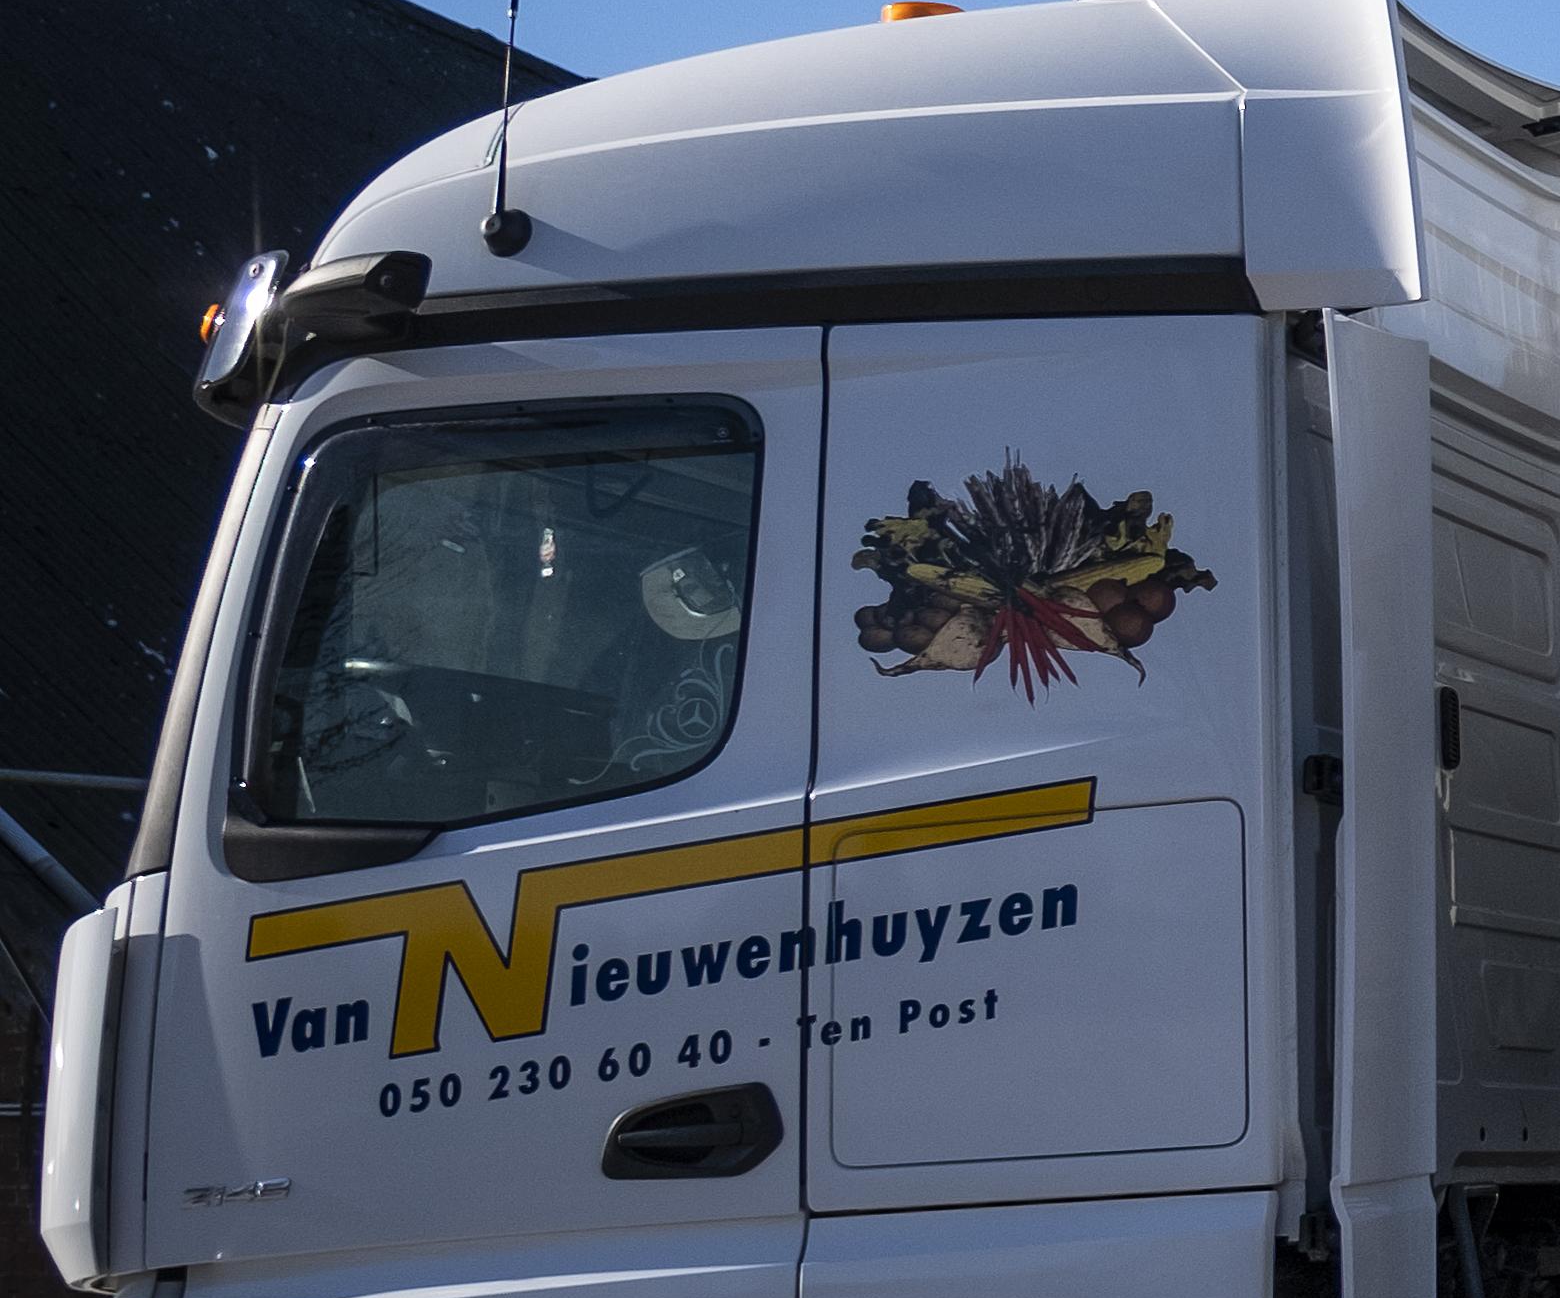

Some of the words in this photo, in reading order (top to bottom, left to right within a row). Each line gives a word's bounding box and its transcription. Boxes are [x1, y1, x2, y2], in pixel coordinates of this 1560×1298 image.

[251, 994, 371, 1059] Van
[388, 867, 1080, 1060] Nieuwenhuyzen
[378, 1072, 462, 1118] 050
[489, 1054, 573, 1102] 230
[599, 1042, 652, 1084] 60
[676, 1028, 734, 1070] 40
[898, 987, 1000, 1034] Post
